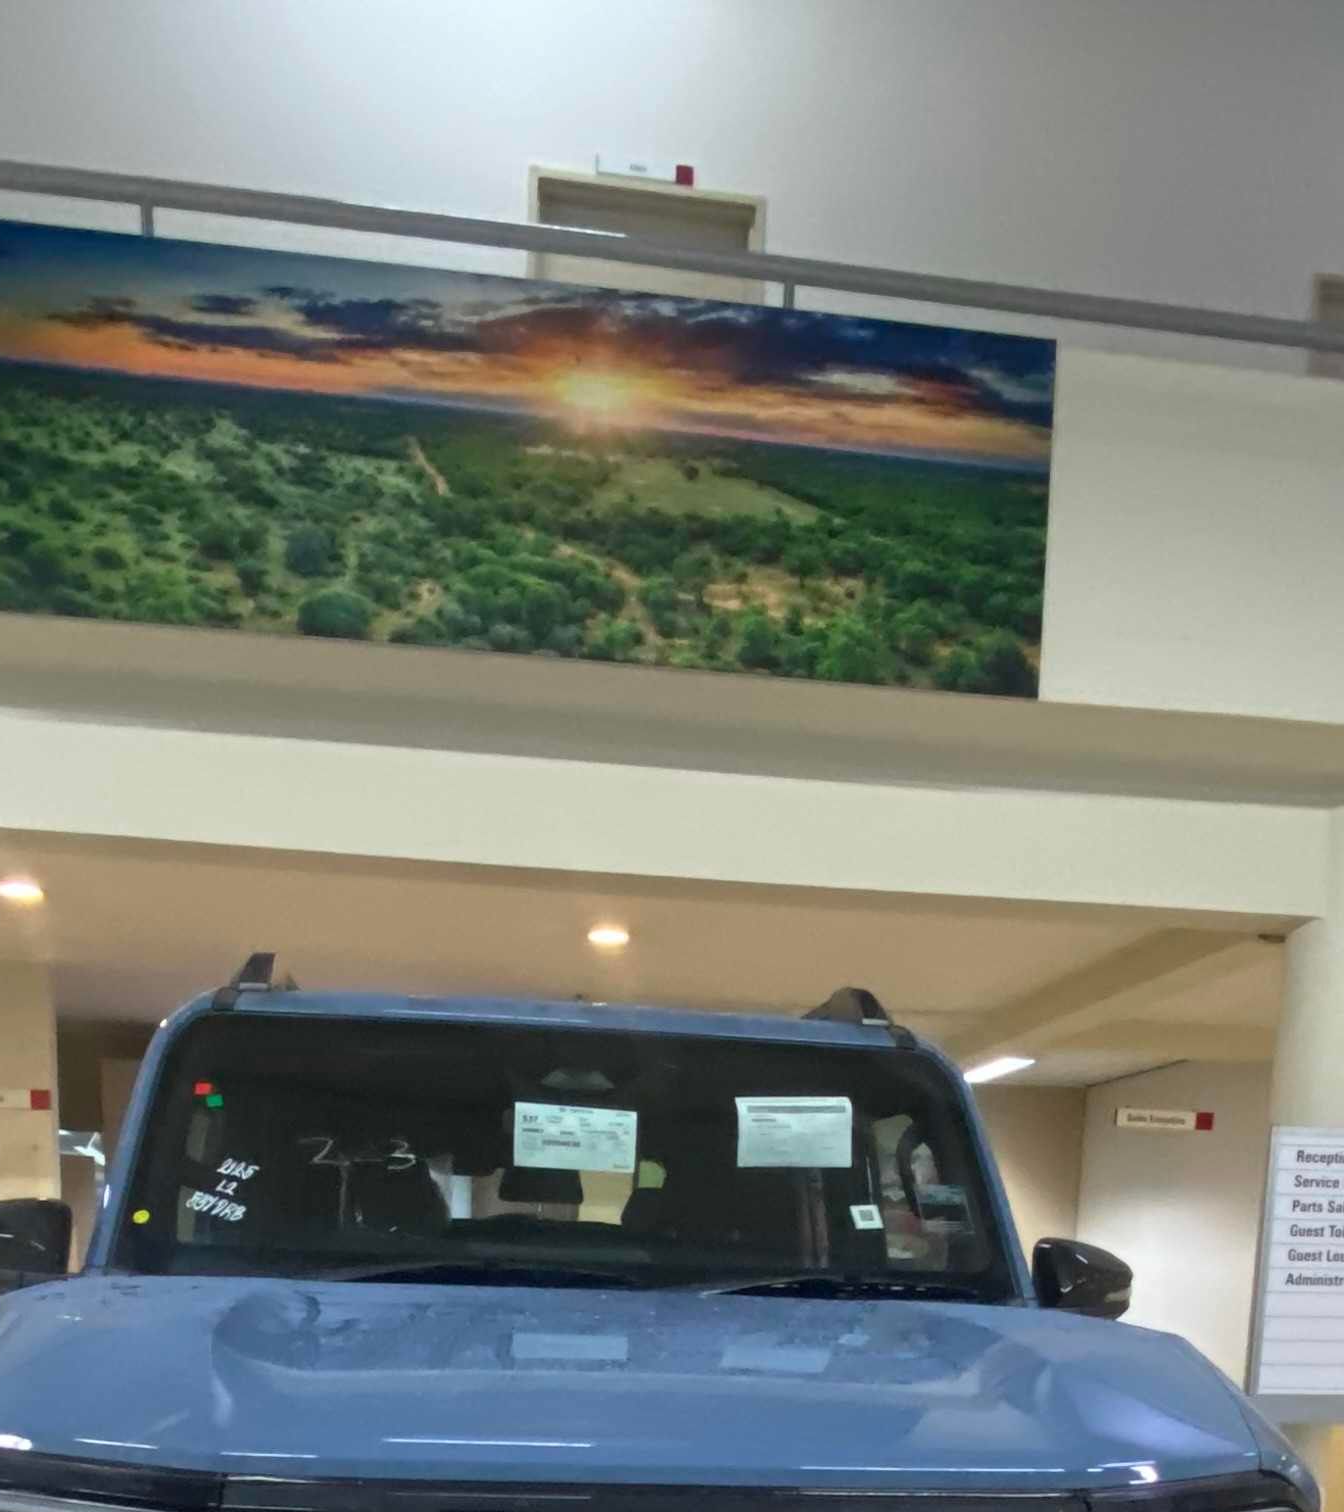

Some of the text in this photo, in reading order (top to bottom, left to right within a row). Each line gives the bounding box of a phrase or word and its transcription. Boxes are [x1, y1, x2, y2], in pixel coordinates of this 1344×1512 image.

[1294, 1175, 1340, 1189] Service
[1292, 1199, 1323, 1213] Parts
[1289, 1224, 1325, 1238] Guest
[1287, 1248, 1323, 1262] Guest
